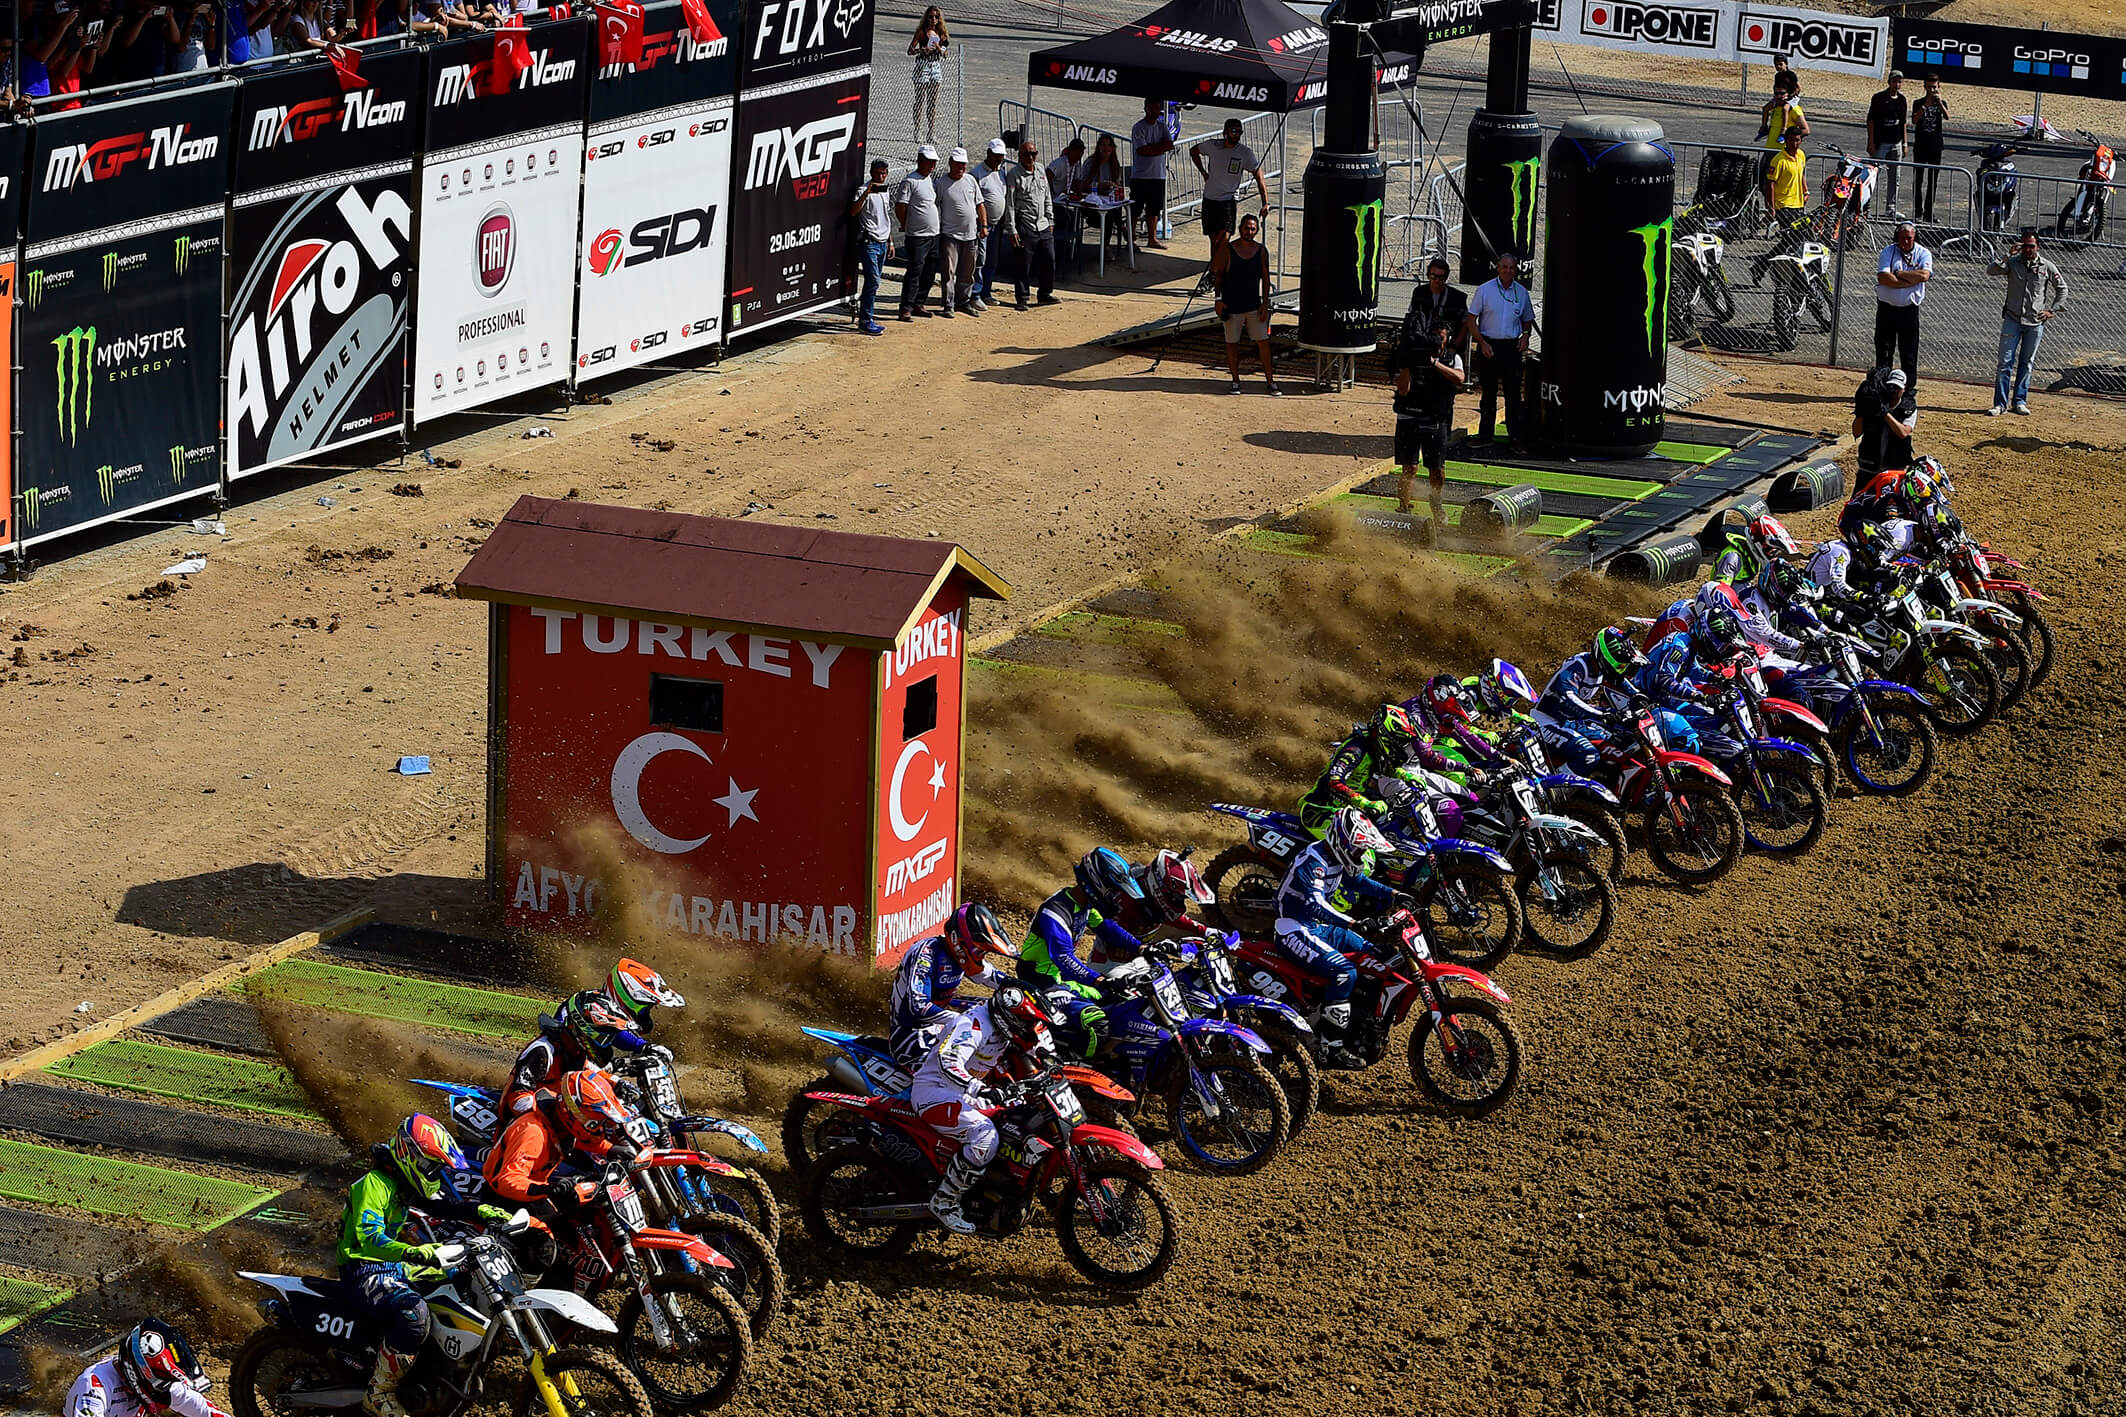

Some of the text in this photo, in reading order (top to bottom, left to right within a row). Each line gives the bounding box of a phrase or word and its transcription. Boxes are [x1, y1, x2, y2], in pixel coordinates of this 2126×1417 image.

[753, 0, 831, 60] FOX
[1281, 26, 1328, 50] ANLAS
[1428, 24, 1474, 41] ENERGY
[1613, 5, 1715, 44] IPONE
[1160, 29, 1238, 52] ANLAS
[1769, 21, 1875, 60] IPONE
[1907, 35, 1983, 55] GoPro
[791, 53, 824, 66] SKYBOX
[2013, 46, 2090, 65] GoPro
[1064, 64, 1118, 85] ANLAS
[1381, 65, 1409, 84] ANLAS
[1213, 82, 1269, 102] ANLAS
[1304, 80, 1328, 101] ANLA
[744, 112, 857, 197] MXGP
[796, 172, 831, 198] PRO
[482, 228, 508, 272] FIAT
[769, 224, 821, 254] 29.06.2018
[226, 185, 411, 480] Airoh
[458, 308, 525, 343] PROFESSIONAL
[97, 327, 187, 368] MONSTER
[109, 358, 173, 382] ENERGY
[289, 328, 361, 440] HELMET
[531, 606, 846, 689] TURKEY
[883, 608, 961, 690] TURKEY
[1257, 831, 1295, 857] 95
[885, 837, 947, 896] MXGP
[876, 876, 954, 957] AFYONKARAHISAR
[1281, 932, 1320, 964] SHIFT
[1249, 971, 1288, 1000] 98
[453, 1097, 498, 1131] 59
[453, 1172, 488, 1195] 27
[486, 1254, 514, 1281] 301
[314, 1312, 355, 1340] 301
